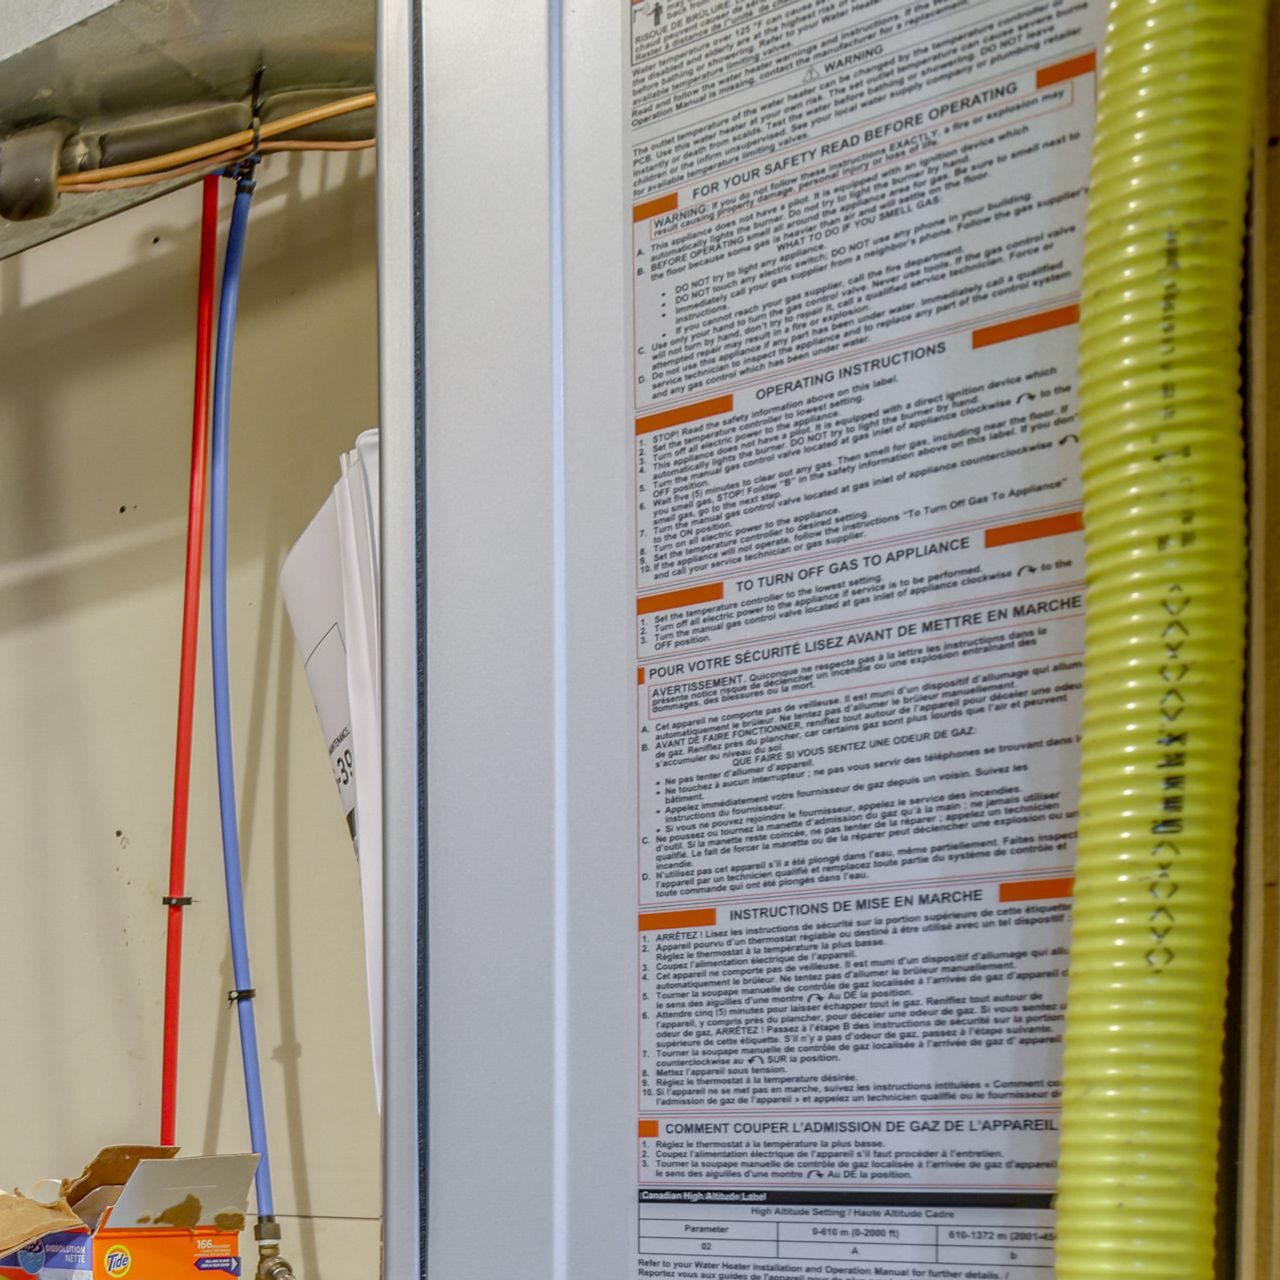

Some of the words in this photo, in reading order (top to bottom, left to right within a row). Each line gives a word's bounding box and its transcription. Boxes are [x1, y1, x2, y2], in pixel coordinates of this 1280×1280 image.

[824, 45, 883, 73] WARNING
[693, 182, 720, 199] FOR
[723, 168, 760, 188] YOUR
[764, 149, 817, 175] SAFETY
[821, 134, 859, 156] READ
[865, 114, 923, 142] BEFORE
[929, 82, 1017, 121] OPERATING
[654, 204, 710, 228] WARNING:
[756, 372, 834, 400] OPERATING
[839, 342, 946, 379] INSTRUCTIONS
[736, 580, 753, 592] TO
[758, 572, 793, 588] TURN
[798, 566, 824, 580] OFF
[829, 559, 858, 574] GAS
[863, 556, 882, 569] TO
[886, 537, 970, 563] APPLIANCE
[649, 663, 684, 679] POUR
[689, 654, 730, 672] VOTRE
[735, 643, 801, 664] SÉCURITÉ
[805, 633, 843, 652] LISEZ
[847, 628, 893, 646] AVANT
[898, 625, 917, 637] DE
[922, 613, 982, 633] METTRE
[987, 609, 1008, 622] EN
[1013, 596, 1082, 618] MARCHE
[730, 903, 828, 920] INSTRUCTIONS
[833, 901, 851, 912] DE
[856, 898, 889, 910] MISE
[895, 895, 913, 907] EN
[918, 890, 983, 905] MARCHE
[666, 1123, 729, 1134] COMMENT
[734, 1123, 788, 1133] COUPER
[792, 1121, 882, 1133] L'ADMISSION
[886, 1121, 905, 1132] DE
[910, 1121, 939, 1131] GAZ
[945, 1120, 964, 1131] DE
[970, 1119, 1058, 1131] L'APPAREIL
[656, 1140, 684, 1149] Réglez
[696, 1140, 743, 1148] thermostat
[763, 1140, 817, 1149] température
[832, 1141, 851, 1149] plus
[855, 1140, 885, 1148] basse.
[642, 1191, 681, 1200] Canadian
[684, 1192, 703, 1201] High
[706, 1192, 739, 1201] Altitude
[742, 1193, 767, 1201] Label
[751, 1207, 771, 1216] High
[775, 1208, 810, 1216] Altitude
[813, 1209, 845, 1218] Setting
[884, 1210, 922, 1218] Altitude
[925, 1210, 954, 1218] Cadre
[685, 1225, 728, 1233] Parameter
[197, 1240, 213, 1249] 166
[701, 1242, 712, 1250] 02
[851, 1247, 859, 1255] A
[65, 1254, 86, 1264] NETTE
[107, 1253, 129, 1272] Tide
